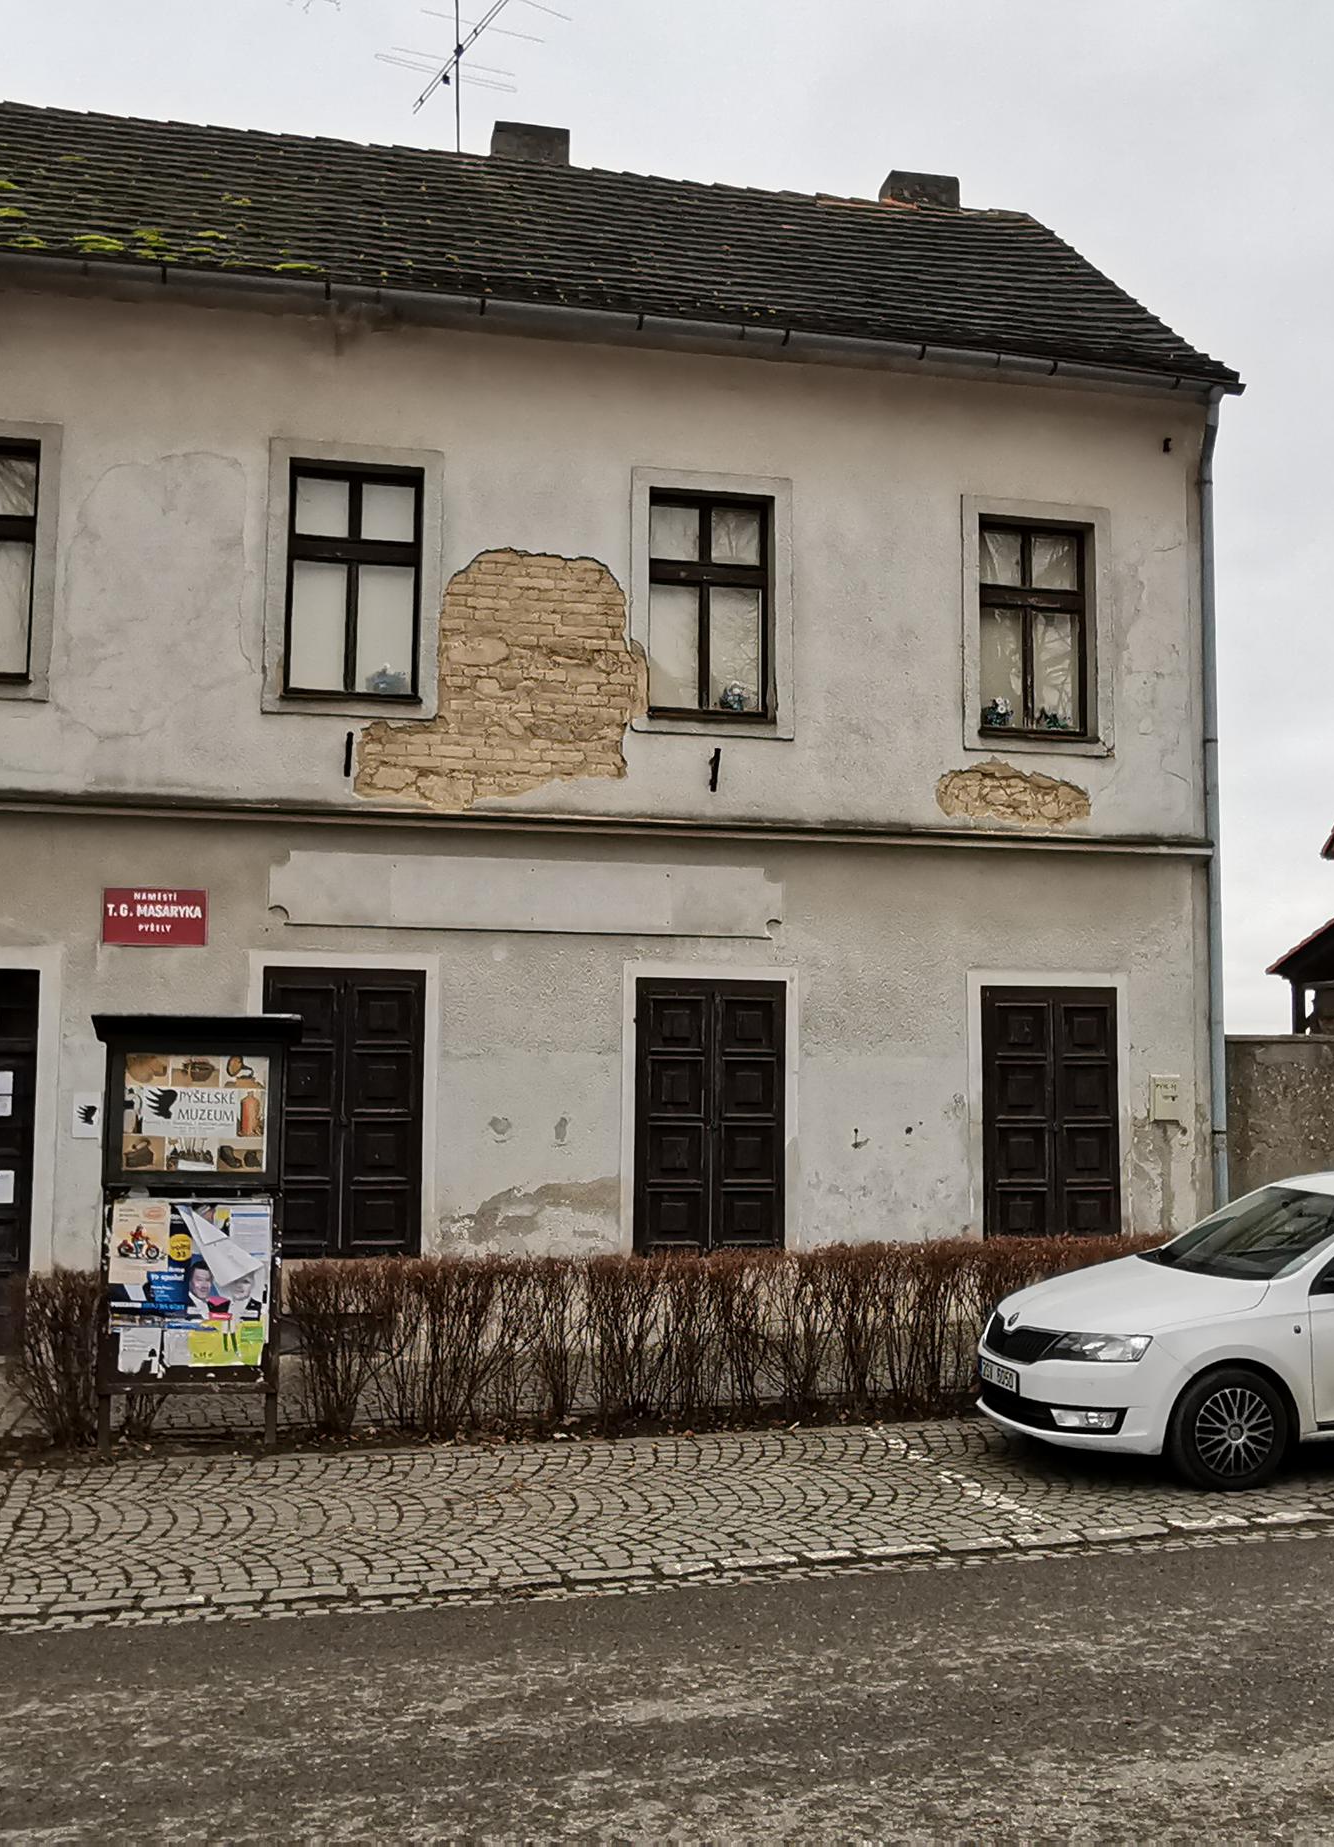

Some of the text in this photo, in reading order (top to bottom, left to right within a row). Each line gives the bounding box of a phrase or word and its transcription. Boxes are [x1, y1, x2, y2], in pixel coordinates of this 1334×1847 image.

[107, 903, 203, 919] T. G. MASARYKA
[178, 1089, 236, 1105] PYŠELSKÉ
[177, 1108, 235, 1122] MUZEUM
